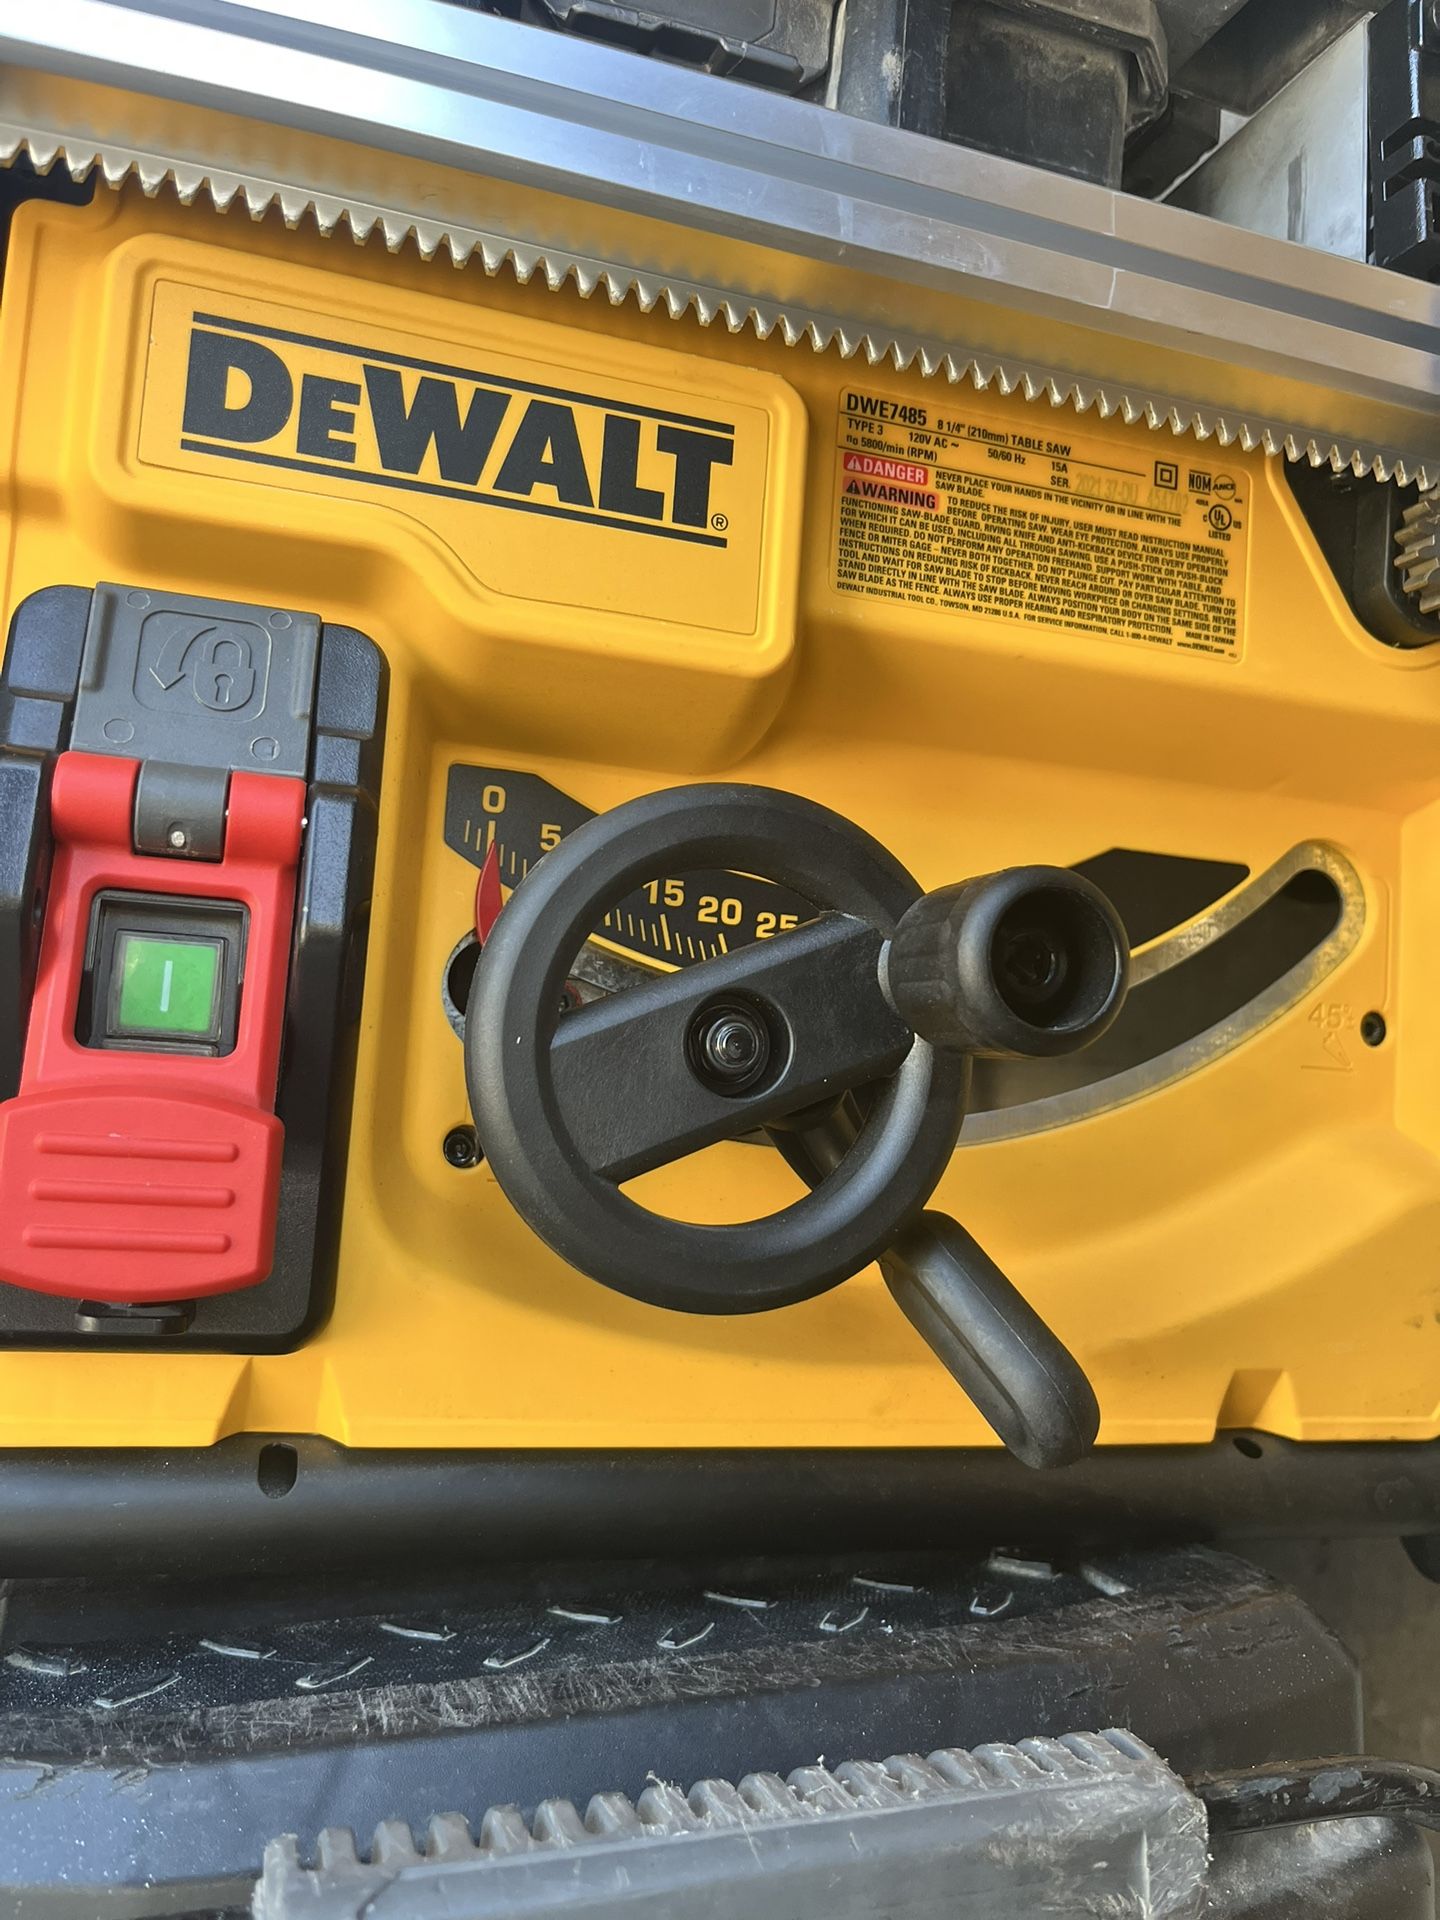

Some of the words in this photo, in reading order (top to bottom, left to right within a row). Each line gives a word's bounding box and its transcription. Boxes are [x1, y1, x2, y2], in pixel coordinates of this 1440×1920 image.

[846, 393, 927, 426] DWE7485
[937, 419, 943, 430] 8
[967, 425, 1008, 444] (210mm)
[1011, 435, 1042, 450] TABLE
[1046, 442, 1070, 456] SAW
[847, 418, 874, 433] TYPE
[877, 424, 883, 435] 3
[908, 431, 931, 445] 120V
[933, 436, 947, 448] AC
[987, 448, 1011, 462] 50/60
[1013, 453, 1025, 465] Hz
[1051, 461, 1067, 473] 15A
[861, 436, 904, 455] 5800/min
[907, 445, 937, 462] (RPM)
[861, 481, 935, 509] WARNING
[863, 458, 924, 483] DANGER
[935, 480, 954, 491] SAW
[935, 470, 962, 483] NEVER
[963, 475, 988, 488] PLACE
[990, 481, 1012, 493] YOUR
[1014, 485, 1042, 499] HANDS
[1043, 491, 1052, 501] IN
[1054, 494, 1068, 504] THE
[1070, 497, 1102, 511] VICINITY
[1105, 504, 1115, 513] OR
[1127, 508, 1143, 519] LINE
[1145, 512, 1165, 523] WITH
[1168, 516, 1181, 526] THE
[1050, 476, 1070, 488] SER.
[1188, 473, 1211, 491] NOM
[840, 505, 856, 517] FOR
[858, 509, 887, 523] WHICH
[889, 515, 896, 524] IT
[899, 517, 917, 528] CAN
[918, 520, 929, 531] BE
[957, 528, 1001, 544] INCLUDING
[1003, 537, 1016, 547] ALL
[1019, 539, 1056, 554] THROUGH
[1094, 554, 1108, 565] USE
[841, 495, 898, 514] FUNCTIONING
[900, 507, 950, 524] SAW-BLADE
[984, 523, 1011, 536] RIVING
[1013, 528, 1035, 540] KNIFE
[1037, 533, 1055, 544] AND
[1117, 549, 1143, 561] DEVICE
[1145, 554, 1159, 564] FOR
[1161, 557, 1184, 569] EVERY
[946, 505, 977, 519] BEFORE
[981, 512, 1026, 529] OPERATING
[1050, 526, 1073, 538] WEAR
[1075, 530, 1088, 541] EYE
[1141, 543, 1173, 557] ALWAYS
[947, 495, 958, 505] TO
[959, 498, 990, 512] REDUCE
[993, 504, 1007, 515] THE
[1009, 508, 1027, 519] RISK
[1029, 511, 1039, 521] OF
[1073, 520, 1093, 532] USER
[1094, 525, 1116, 536] MUST
[1118, 529, 1138, 541] READ
[1140, 533, 1190, 551] INSTRUCTION
[1208, 529, 1231, 541] LISTED
[839, 526, 865, 540] FENCE
[867, 531, 879, 542] OR
[881, 534, 907, 547] MITER
[909, 539, 931, 552] GAGE
[940, 545, 967, 558] NEVER
[968, 550, 990, 562] BOTH
[1037, 563, 1048, 573] DO
[1050, 565, 1065, 576] NOT
[1067, 569, 1097, 582] PLUNGE
[1118, 578, 1133, 588] PAY
[1135, 581, 1181, 598] PARTICULAR
[1183, 590, 1224, 605] ATTENTION
[839, 537, 900, 556] INSTRUCTIONS
[902, 548, 914, 559] ON
[916, 551, 958, 567] REDUCING
[959, 559, 978, 570] RISK
[980, 562, 989, 572] OF
[1034, 572, 1059, 585] NEVER
[1061, 577, 1086, 590] REACH
[1088, 583, 1120, 596] AROUND
[1122, 589, 1132, 598] OR
[1134, 591, 1153, 602] OVER
[1155, 595, 1173, 606] SAW
[840, 516, 866, 529] WHEN
[913, 530, 925, 540] DO
[927, 532, 944, 543] NOT
[946, 536, 984, 551] PERFORM
[986, 543, 1003, 554] ANY
[1005, 547, 1050, 563] OPERATION
[1095, 564, 1129, 578] SUPPORT
[1131, 571, 1154, 583] WORK
[1156, 575, 1176, 587] WITH
[837, 568, 856, 580] SAW
[858, 572, 883, 585] BLADE
[886, 577, 896, 587] AS
[898, 579, 913, 590] THE
[943, 586, 975, 600] ALWAYS
[977, 592, 992, 603] USE
[993, 595, 1023, 608] PROPER
[1024, 601, 1058, 615] HEARING
[1059, 607, 1075, 617] AND
[1077, 610, 1125, 626] RESPIRATORY
[838, 557, 866, 571] STAND
[868, 563, 906, 578] DIRECTLY
[907, 570, 917, 580] IN
[918, 572, 936, 583] LINE
[938, 575, 960, 587] WITH
[962, 579, 976, 590] THE
[978, 582, 997, 594] SAW
[1028, 591, 1060, 605] ALWAYS
[1062, 597, 1098, 612] POSITION
[1099, 604, 1119, 615] YOUR
[1121, 608, 1141, 619] BODY
[1157, 614, 1169, 624] THE
[1171, 617, 1192, 628] SAME
[839, 547, 858, 559] TOOL
[862, 551, 880, 563] AND
[882, 555, 903, 567] WAIT
[906, 559, 921, 570] FOR
[923, 562, 943, 574] SAW
[945, 566, 971, 579] BLADE
[974, 571, 984, 581] TO
[985, 573, 1006, 585] STOP
[1008, 577, 1037, 591] BEFORE
[1039, 583, 1071, 597] MOVING
[1073, 589, 1117, 605] WORKPIECE
[1119, 598, 1129, 607] OR
[1131, 600, 1171, 615] CHANGING
[482, 785, 506, 813] 0
[540, 823, 562, 851] 5
[642, 879, 685, 906] 15
[697, 896, 743, 926] 20
[755, 912, 798, 938] 25
